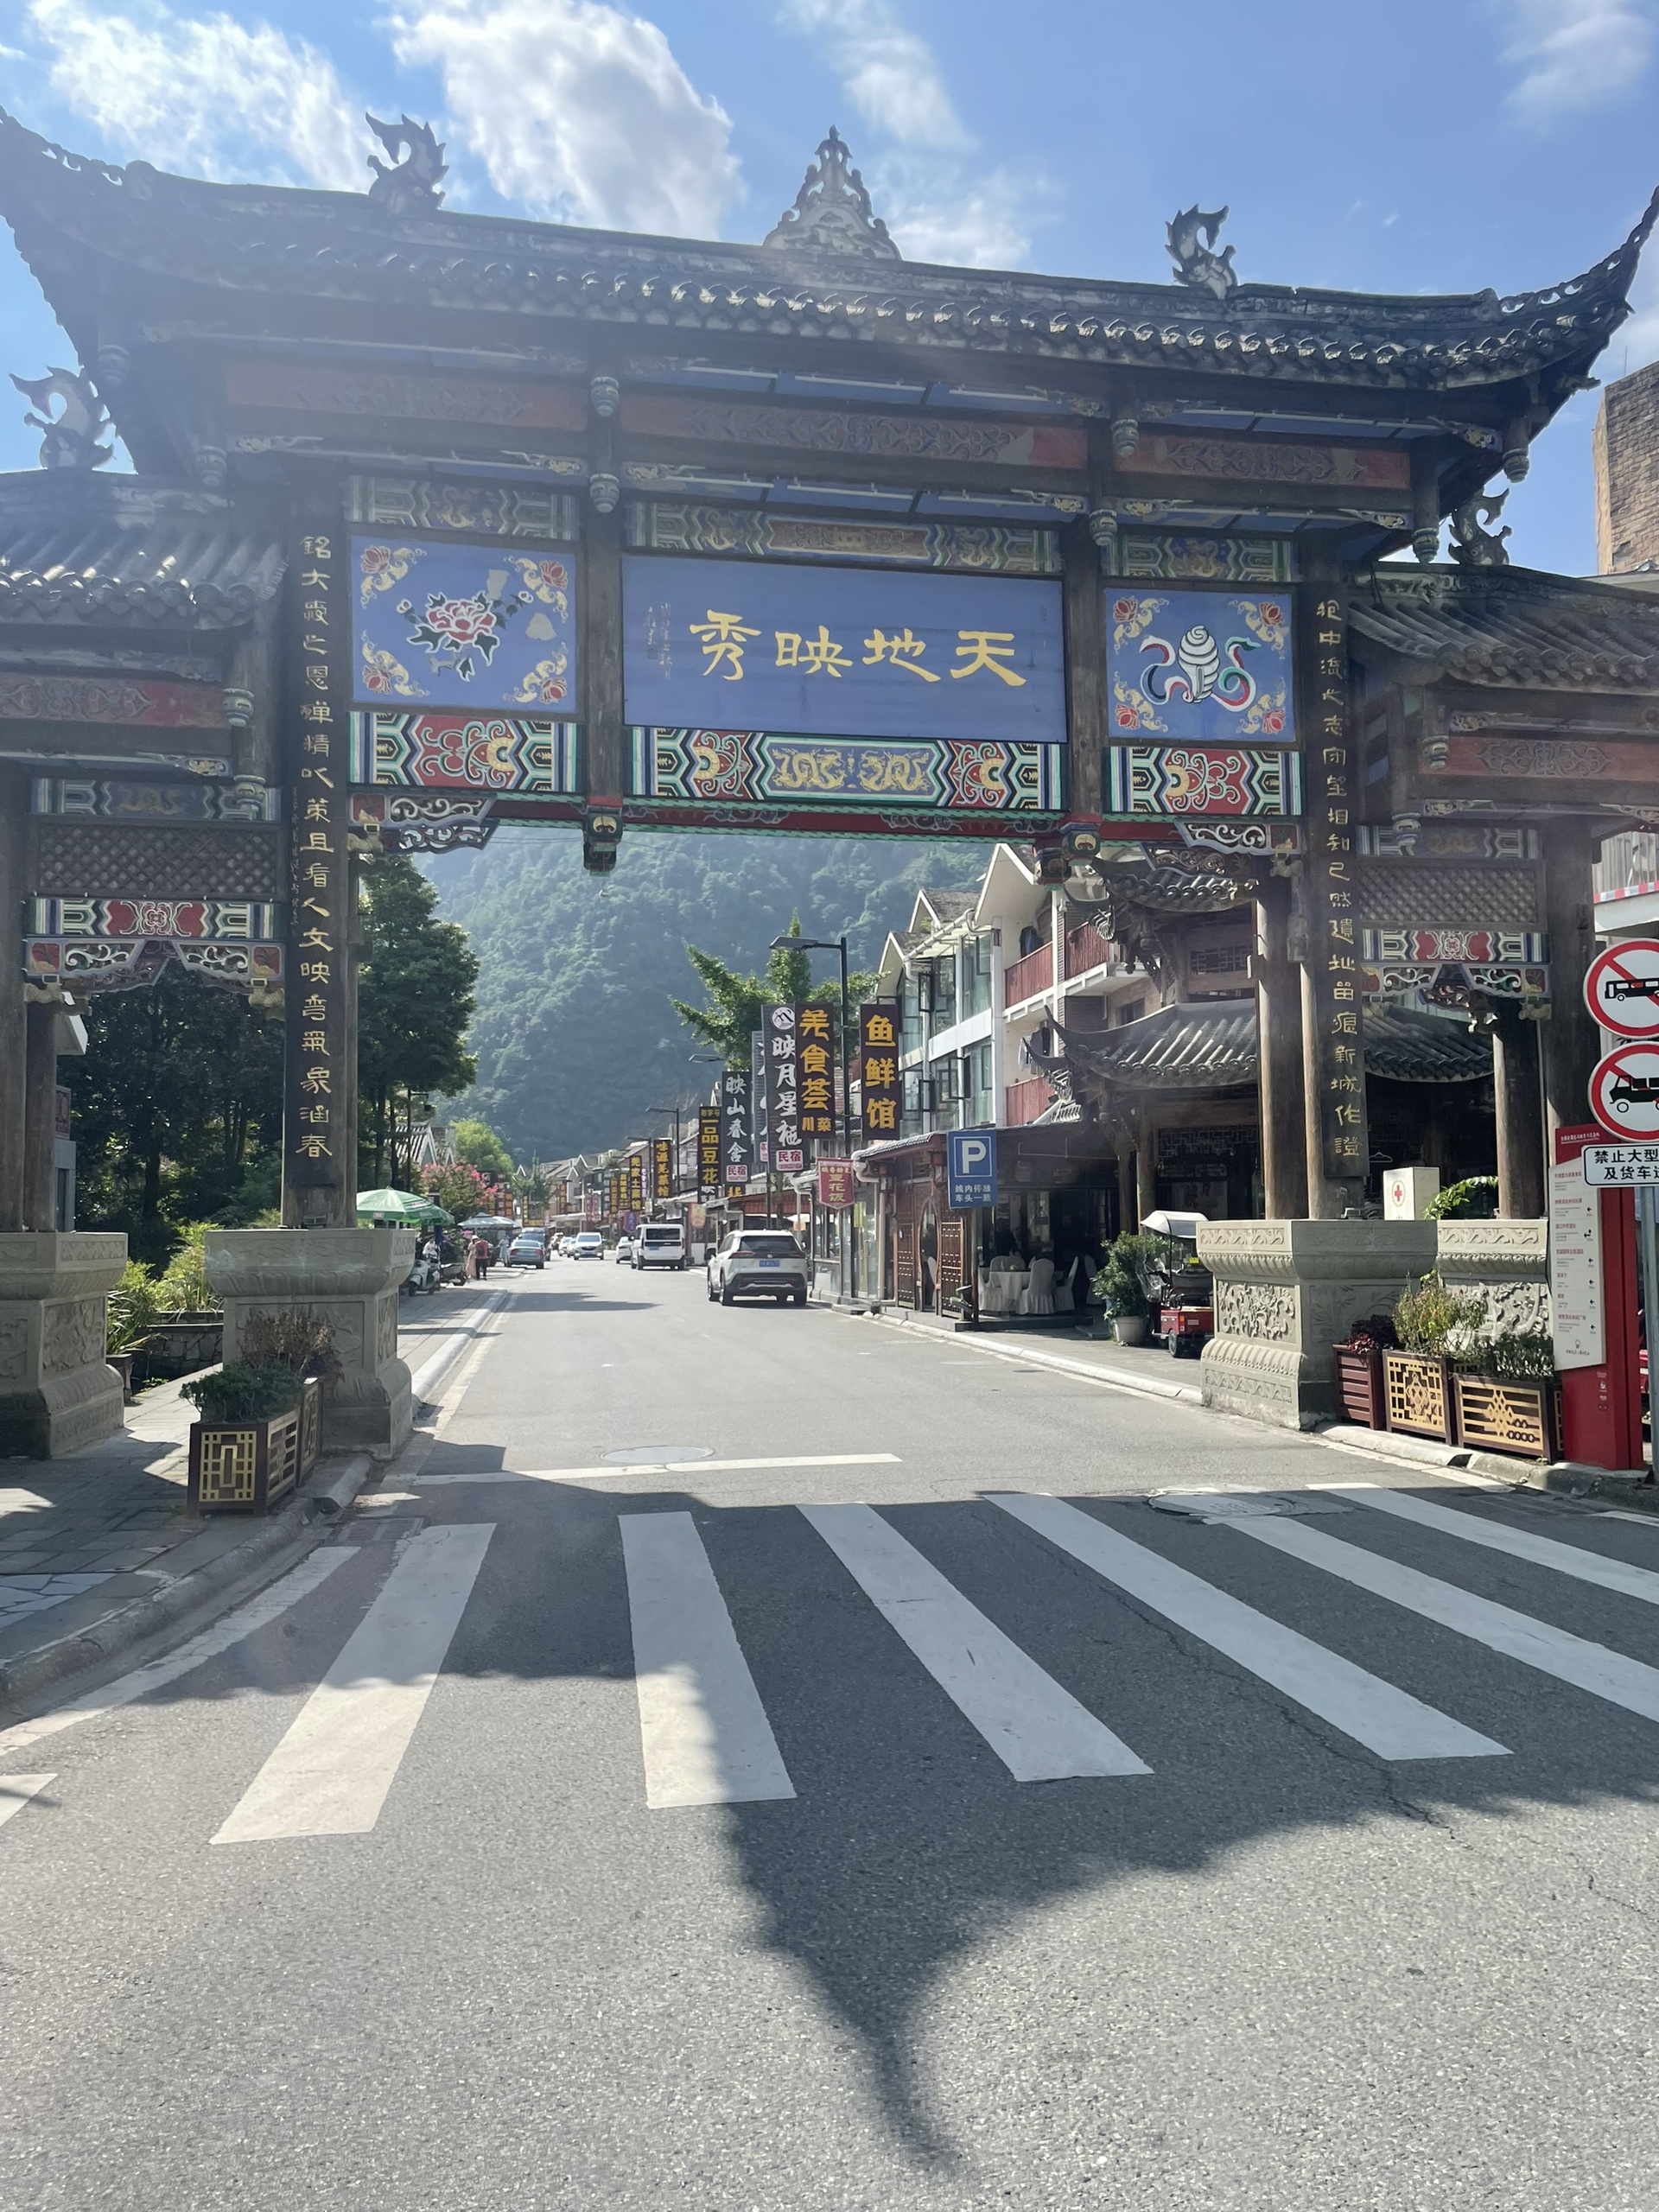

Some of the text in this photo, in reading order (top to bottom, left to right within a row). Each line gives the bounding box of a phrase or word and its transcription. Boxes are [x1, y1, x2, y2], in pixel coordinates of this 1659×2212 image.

[689, 609, 1027, 688] 天地映秀
[864, 1014, 897, 1129] 鱼鲜馆
[772, 1036, 802, 1147] 映月星栖
[726, 1074, 747, 1163] 映山春舍
[801, 1116, 832, 1132] 川菜
[702, 1119, 719, 1185] 一品豆花
[779, 1151, 801, 1162] 民宿
[962, 1141, 987, 1173] P
[1594, 1148, 1659, 1164] 禁止大型
[728, 1166, 746, 1175] 民宿
[829, 1174, 846, 1202] 豆花饭
[955, 1184, 991, 1193] 线内停放
[955, 1193, 992, 1203] 车头一致
